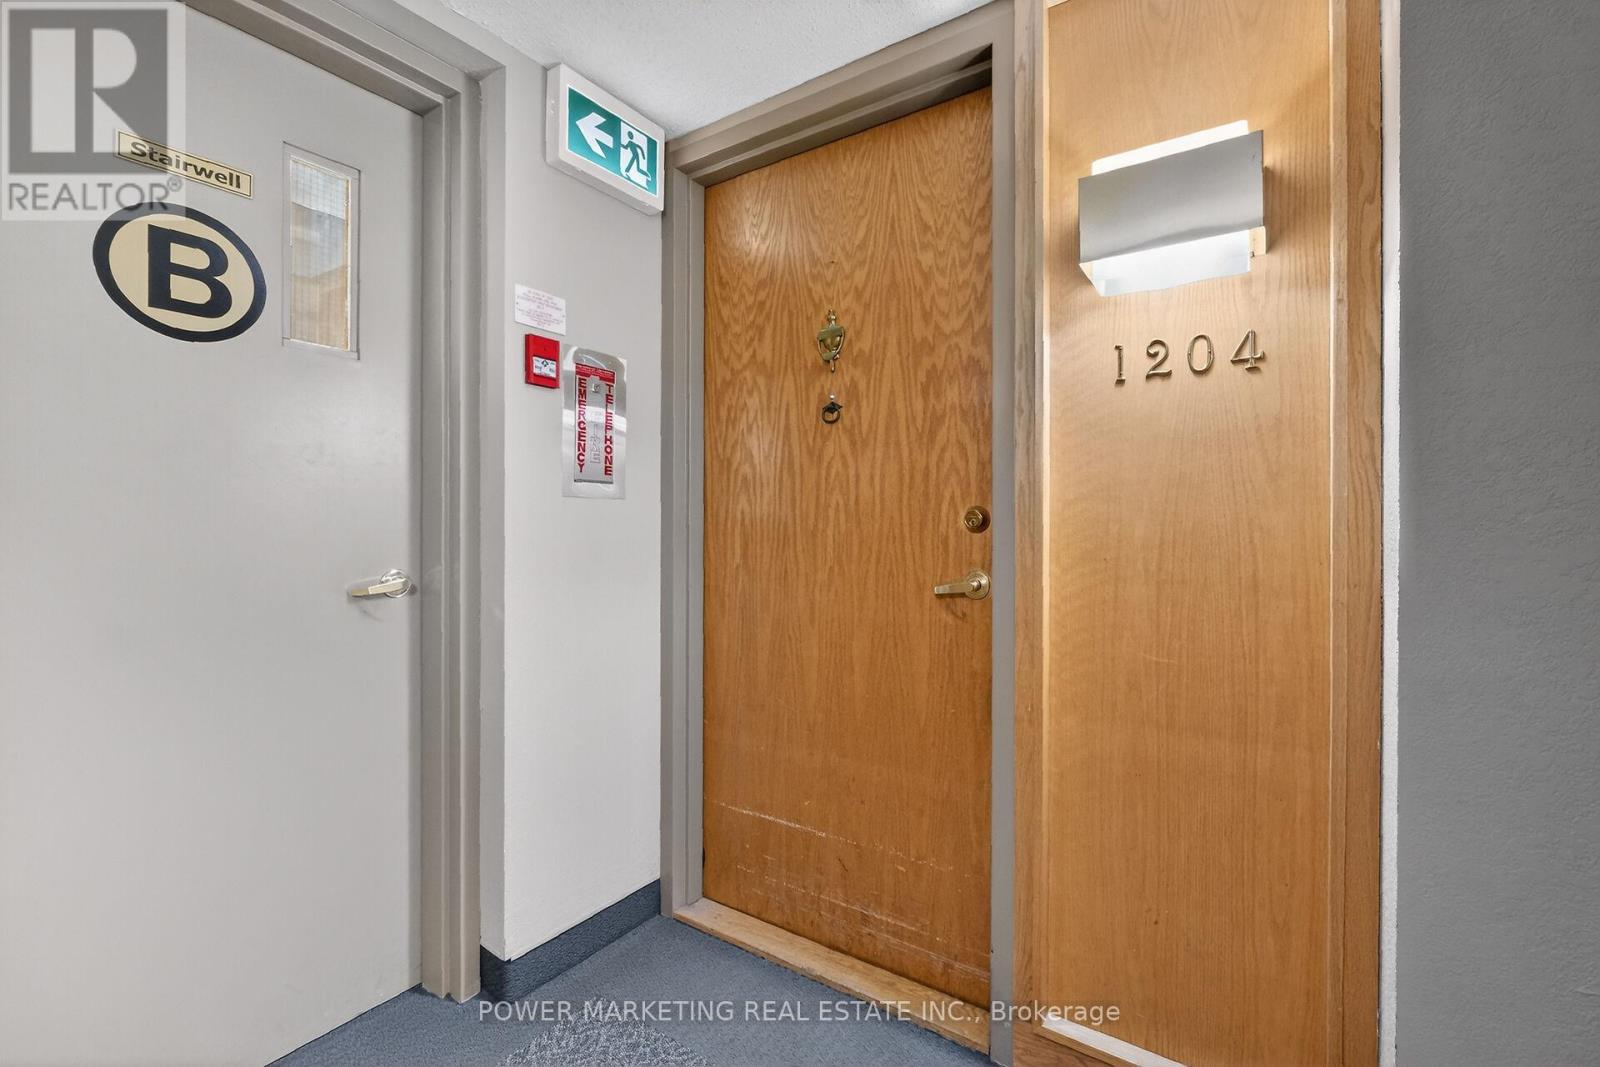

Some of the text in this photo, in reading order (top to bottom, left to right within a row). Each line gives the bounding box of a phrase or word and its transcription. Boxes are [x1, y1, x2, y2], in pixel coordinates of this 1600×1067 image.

[130, 141, 241, 189] Stairwell
[148, 224, 233, 319] B
[1114, 329, 1266, 386] 1204
[576, 377, 587, 473] EMERGENCY
[603, 383, 614, 476] TELEPHONE
